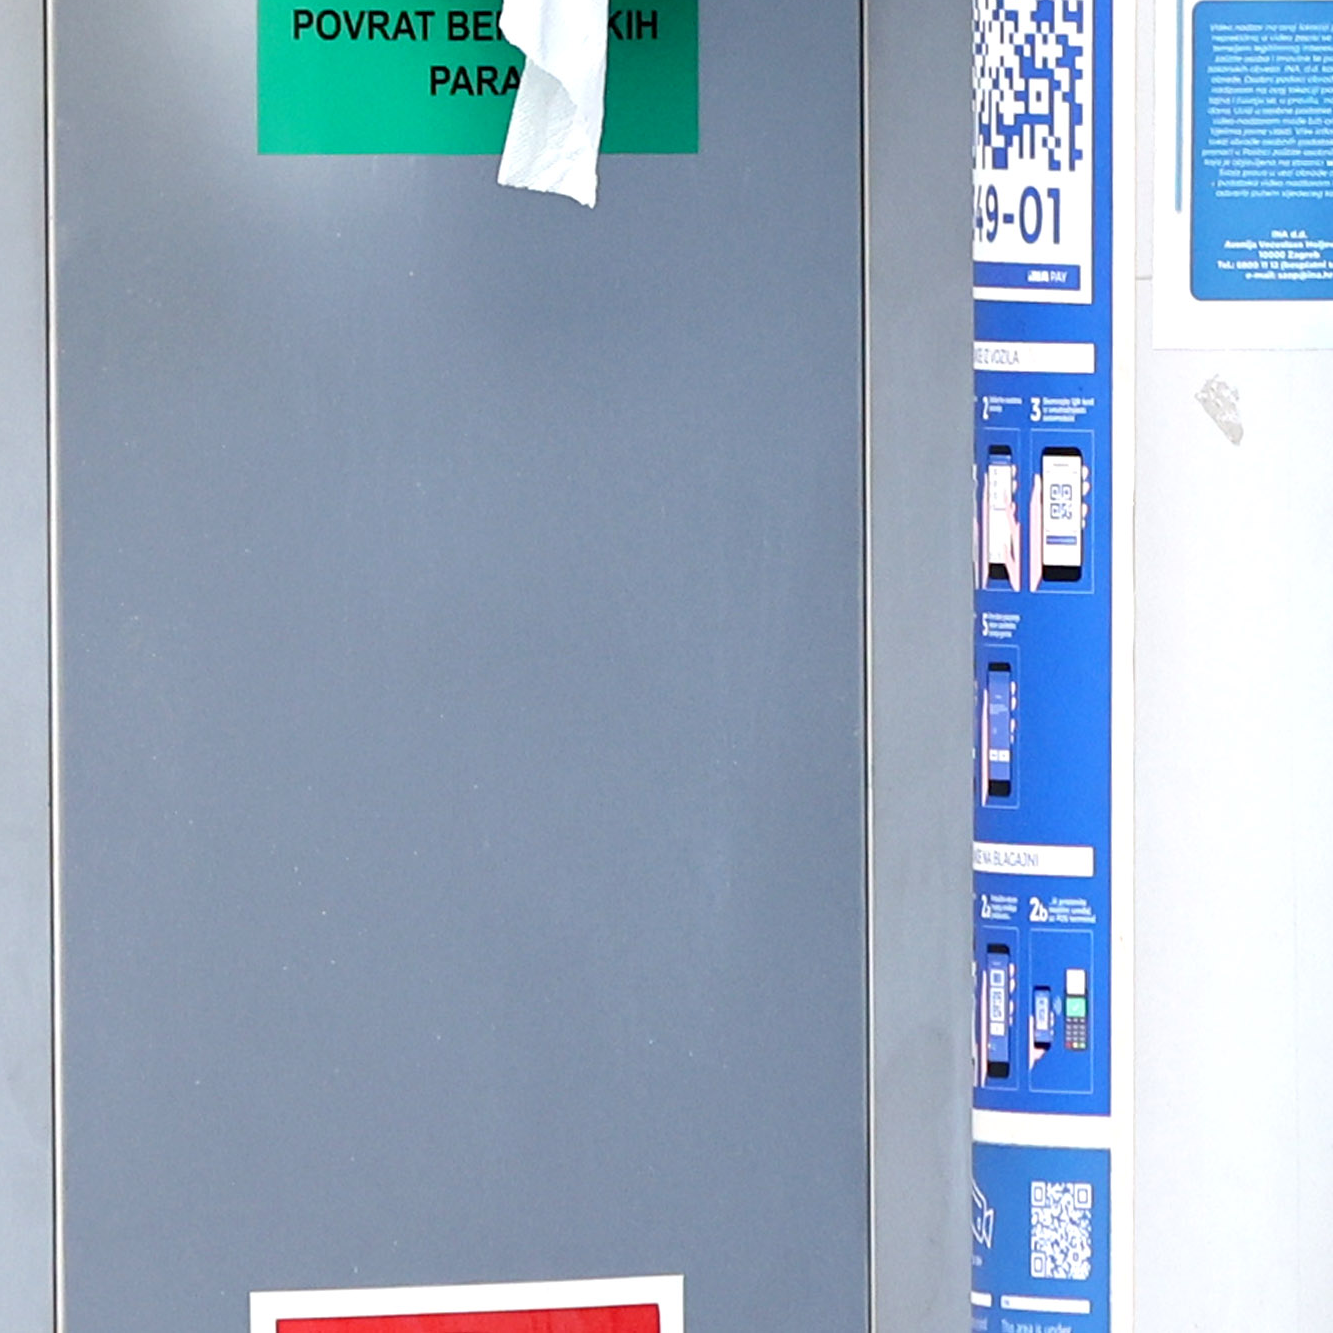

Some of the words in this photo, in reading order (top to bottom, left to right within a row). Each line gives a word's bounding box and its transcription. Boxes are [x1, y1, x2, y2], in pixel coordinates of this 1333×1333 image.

[293, 10, 435, 41] POVRAT
[430, 65, 521, 96] PARA
[1030, 397, 1041, 422] 3
[1029, 897, 1048, 922] 2b
